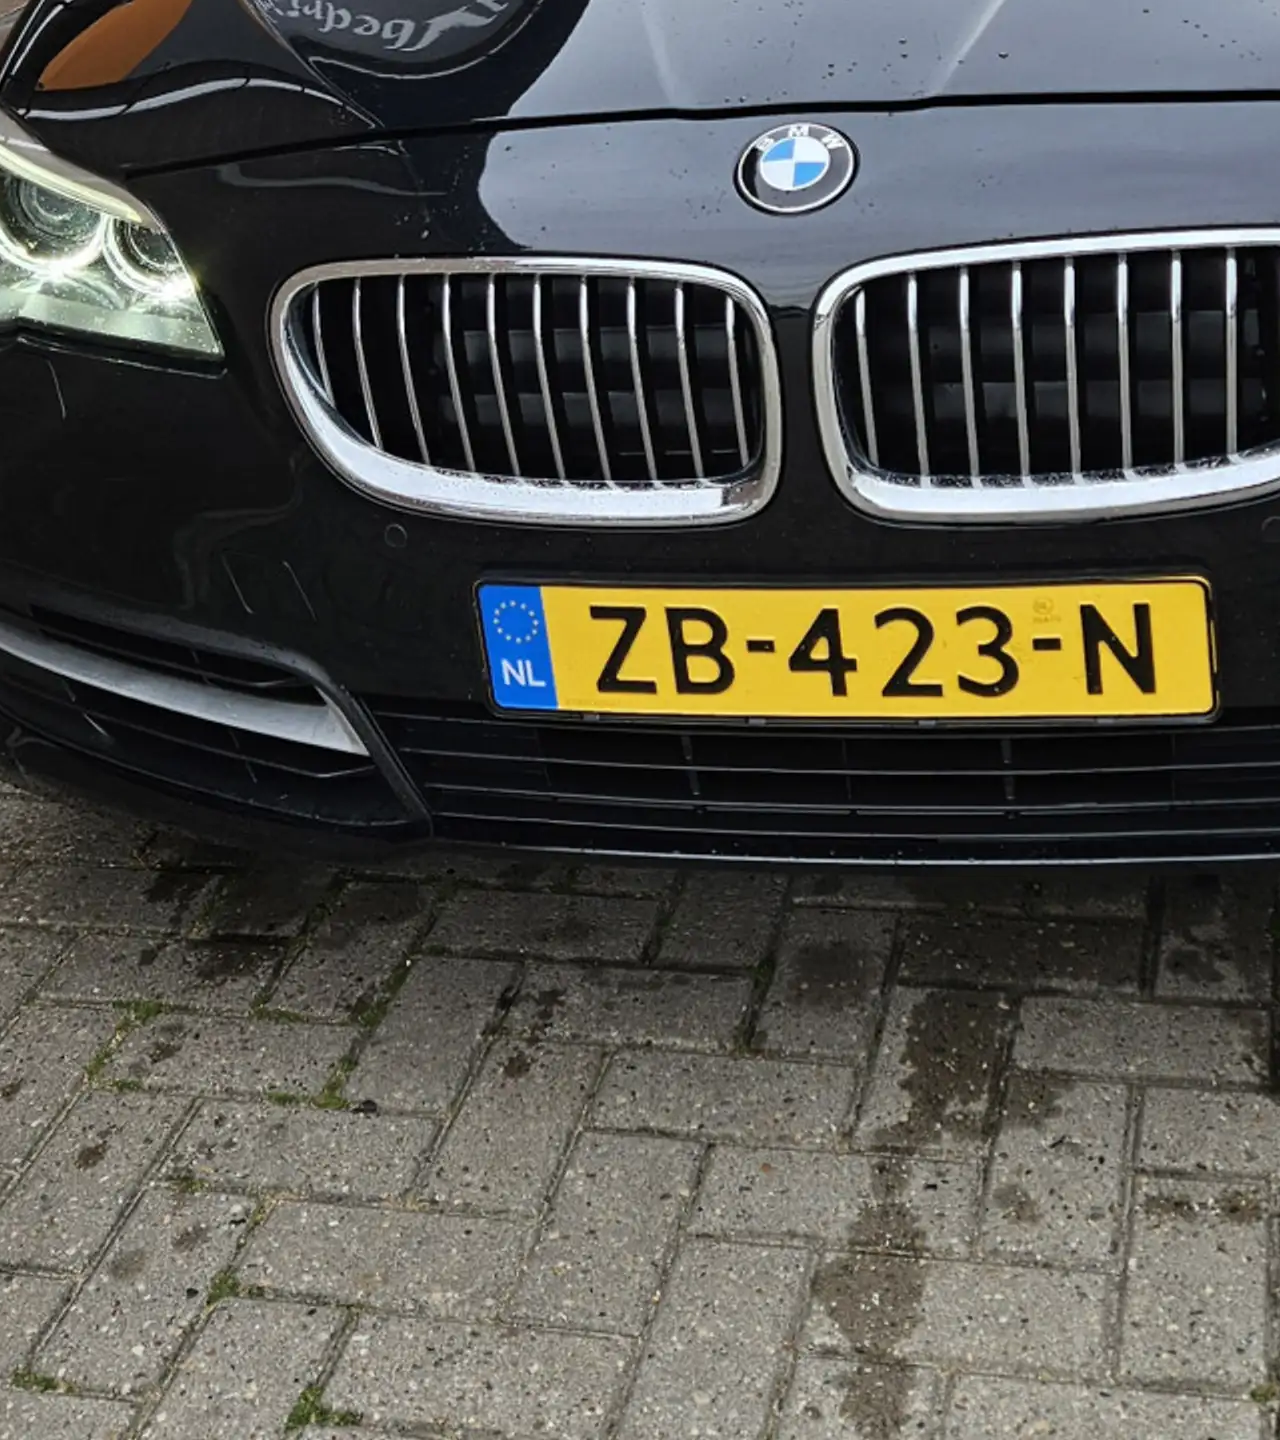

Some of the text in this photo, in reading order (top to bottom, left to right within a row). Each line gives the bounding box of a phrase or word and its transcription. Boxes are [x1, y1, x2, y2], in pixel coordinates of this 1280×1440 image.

[755, 124, 846, 152] BMW
[501, 658, 547, 687] NL
[589, 602, 1157, 698] ZB-423-N
